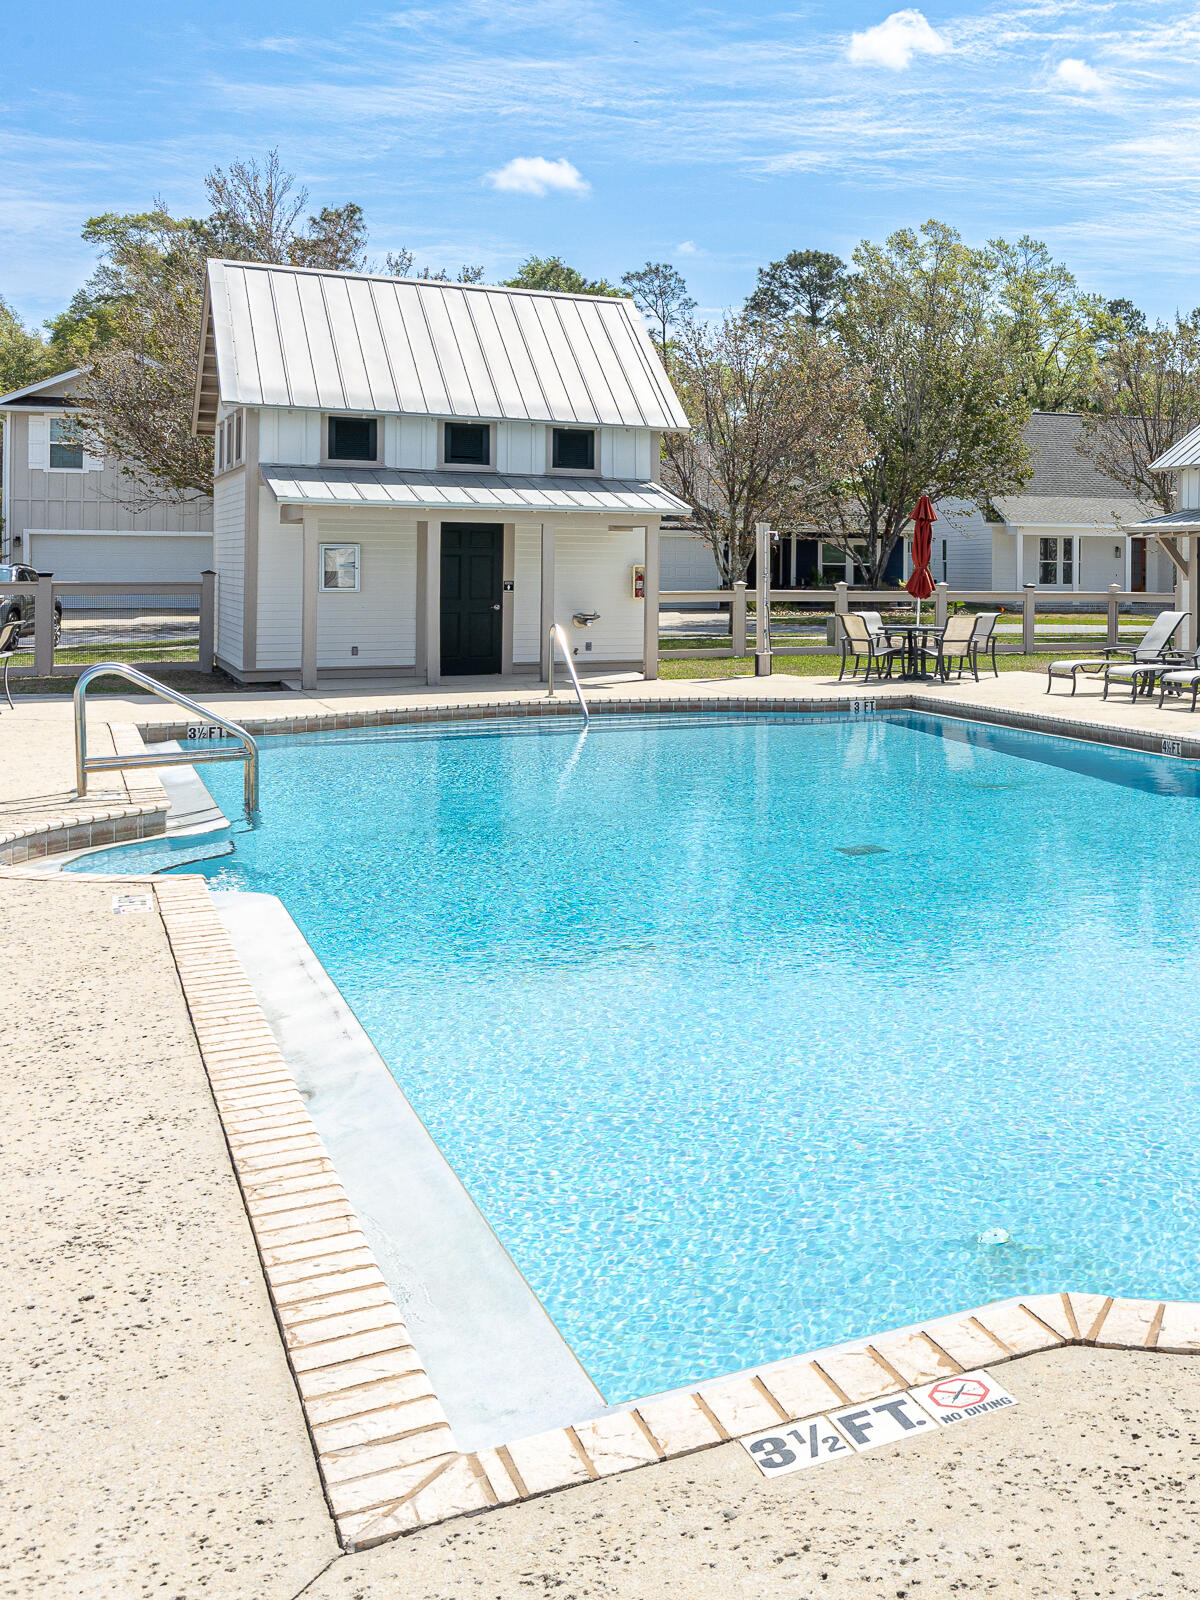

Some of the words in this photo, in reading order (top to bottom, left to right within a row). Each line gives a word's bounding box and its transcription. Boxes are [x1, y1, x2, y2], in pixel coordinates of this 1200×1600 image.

[837, 1399, 927, 1445] FT.
[940, 1412, 963, 1424] NO
[964, 1397, 1013, 1416] DIVING
